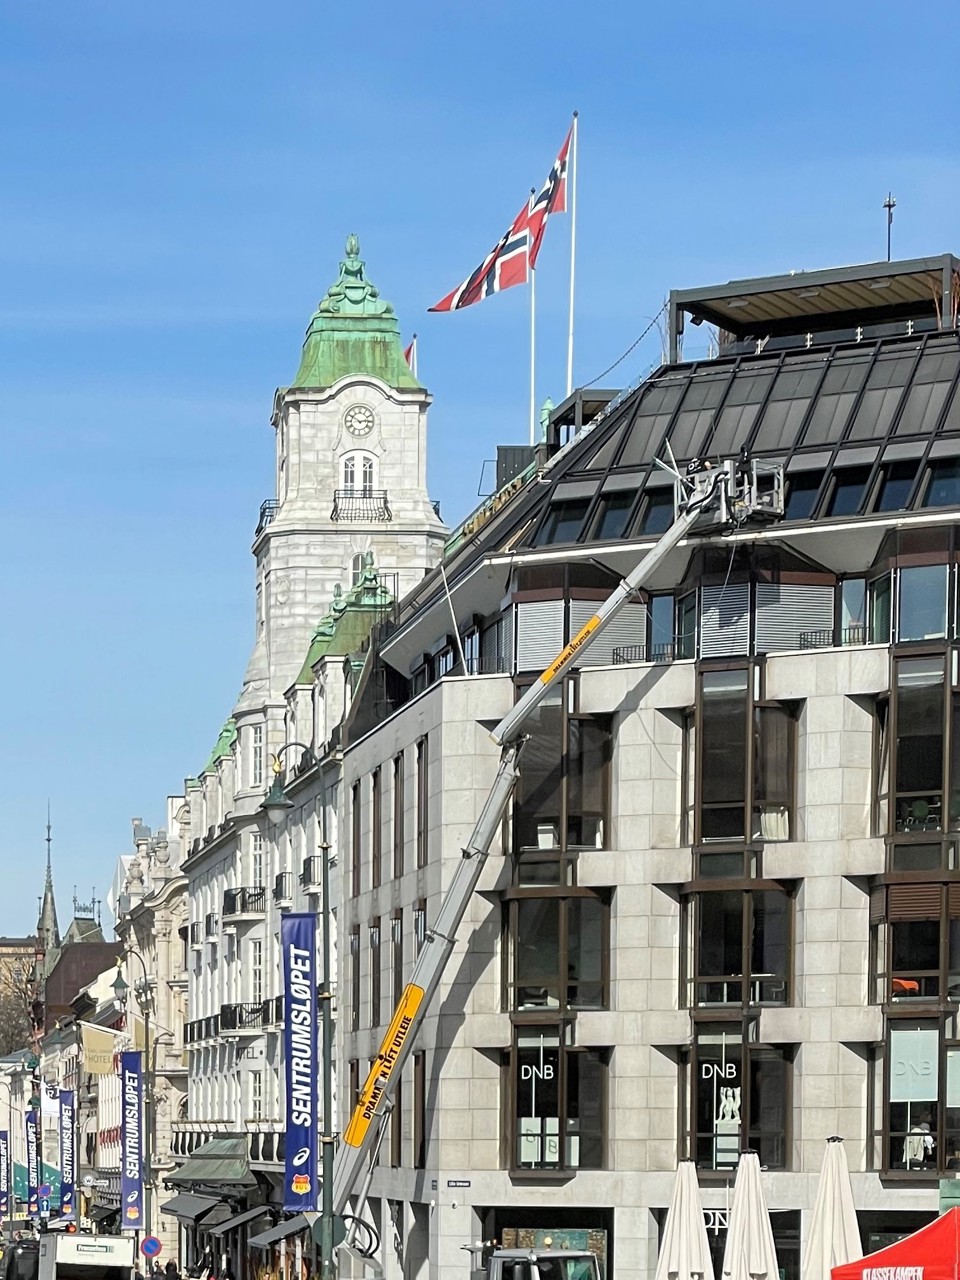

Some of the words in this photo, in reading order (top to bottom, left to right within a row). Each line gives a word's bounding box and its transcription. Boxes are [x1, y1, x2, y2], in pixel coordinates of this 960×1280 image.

[290, 943, 311, 1128] SENTRUMSLØPET
[362, 1070, 389, 1120] DRAMMN
[393, 1015, 412, 1048] UTLEIE
[521, 1065, 554, 1080] DNB
[702, 1063, 737, 1079] DNB
[28, 1121, 37, 1188] SENTRUMSLØPET
[61, 1103, 72, 1185] SENTRUMSLØPET
[126, 1069, 139, 1179] SENTRUMSLØPET
